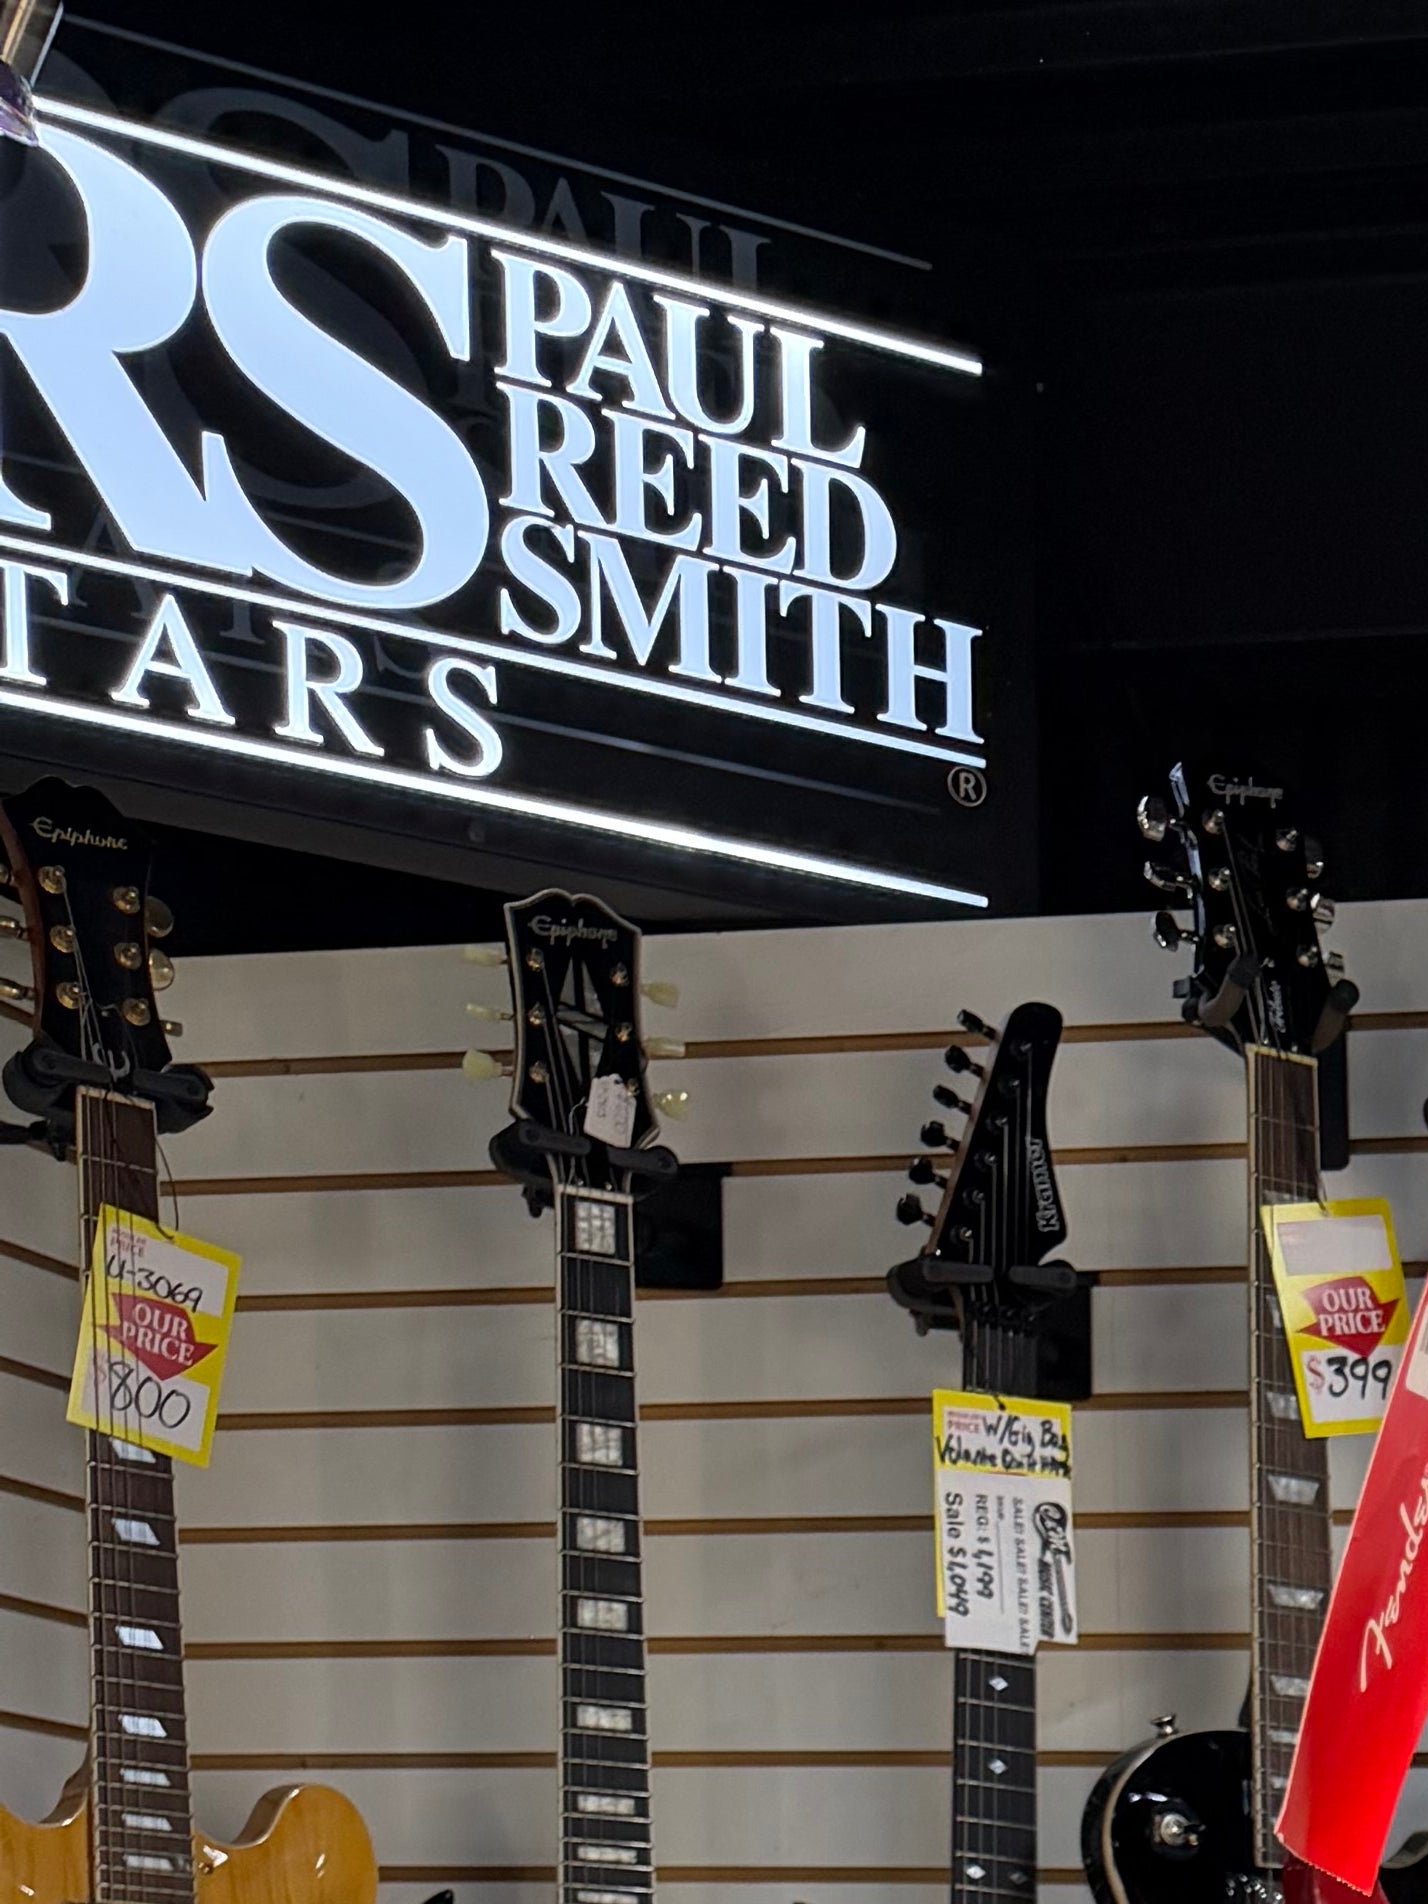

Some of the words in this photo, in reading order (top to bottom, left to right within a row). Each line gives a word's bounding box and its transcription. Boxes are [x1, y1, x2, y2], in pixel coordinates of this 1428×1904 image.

[491, 248, 866, 471] PAUL
[495, 381, 898, 592] REED
[500, 516, 985, 746] SMITH
[1206, 772, 1283, 808] Epiphone
[30, 816, 128, 850] Epiphone
[527, 914, 618, 949] Epiphone
[105, 1254, 204, 1312] U-3069
[1322, 1286, 1374, 1312] OUR
[132, 1301, 189, 1341] OUR
[1318, 1308, 1386, 1337] PRICE
[121, 1324, 194, 1367] PRICE
[1306, 1356, 1393, 1400] $399
[944, 1491, 966, 1540] Sale
